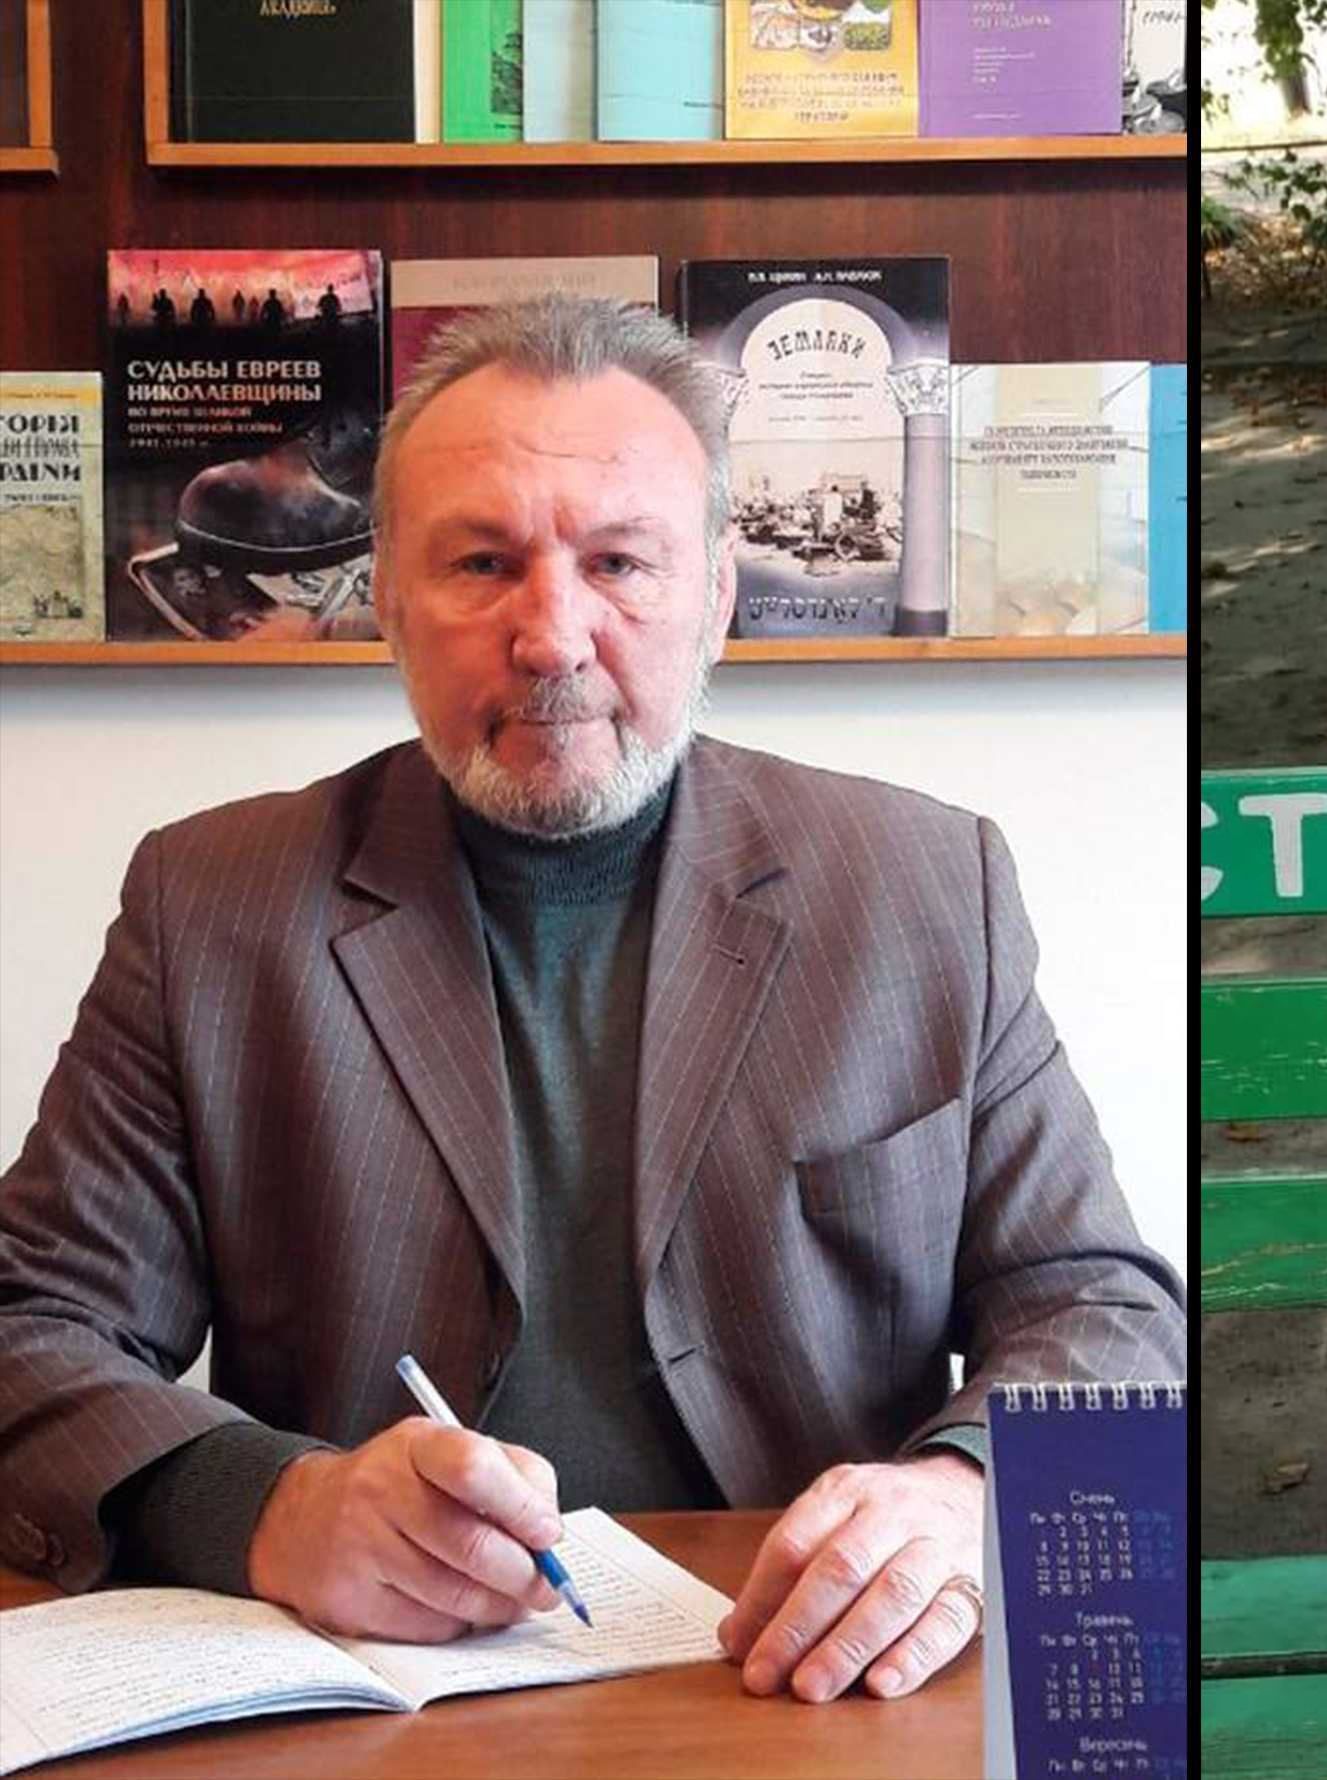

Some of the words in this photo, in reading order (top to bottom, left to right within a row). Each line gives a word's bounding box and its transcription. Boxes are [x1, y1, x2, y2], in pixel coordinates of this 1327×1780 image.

[127, 360, 229, 383] СУДЬБЫ
[236, 360, 322, 379] ЕВРЕЕВ
[127, 384, 322, 406] НИКОЛАЕВЩИНЫ
